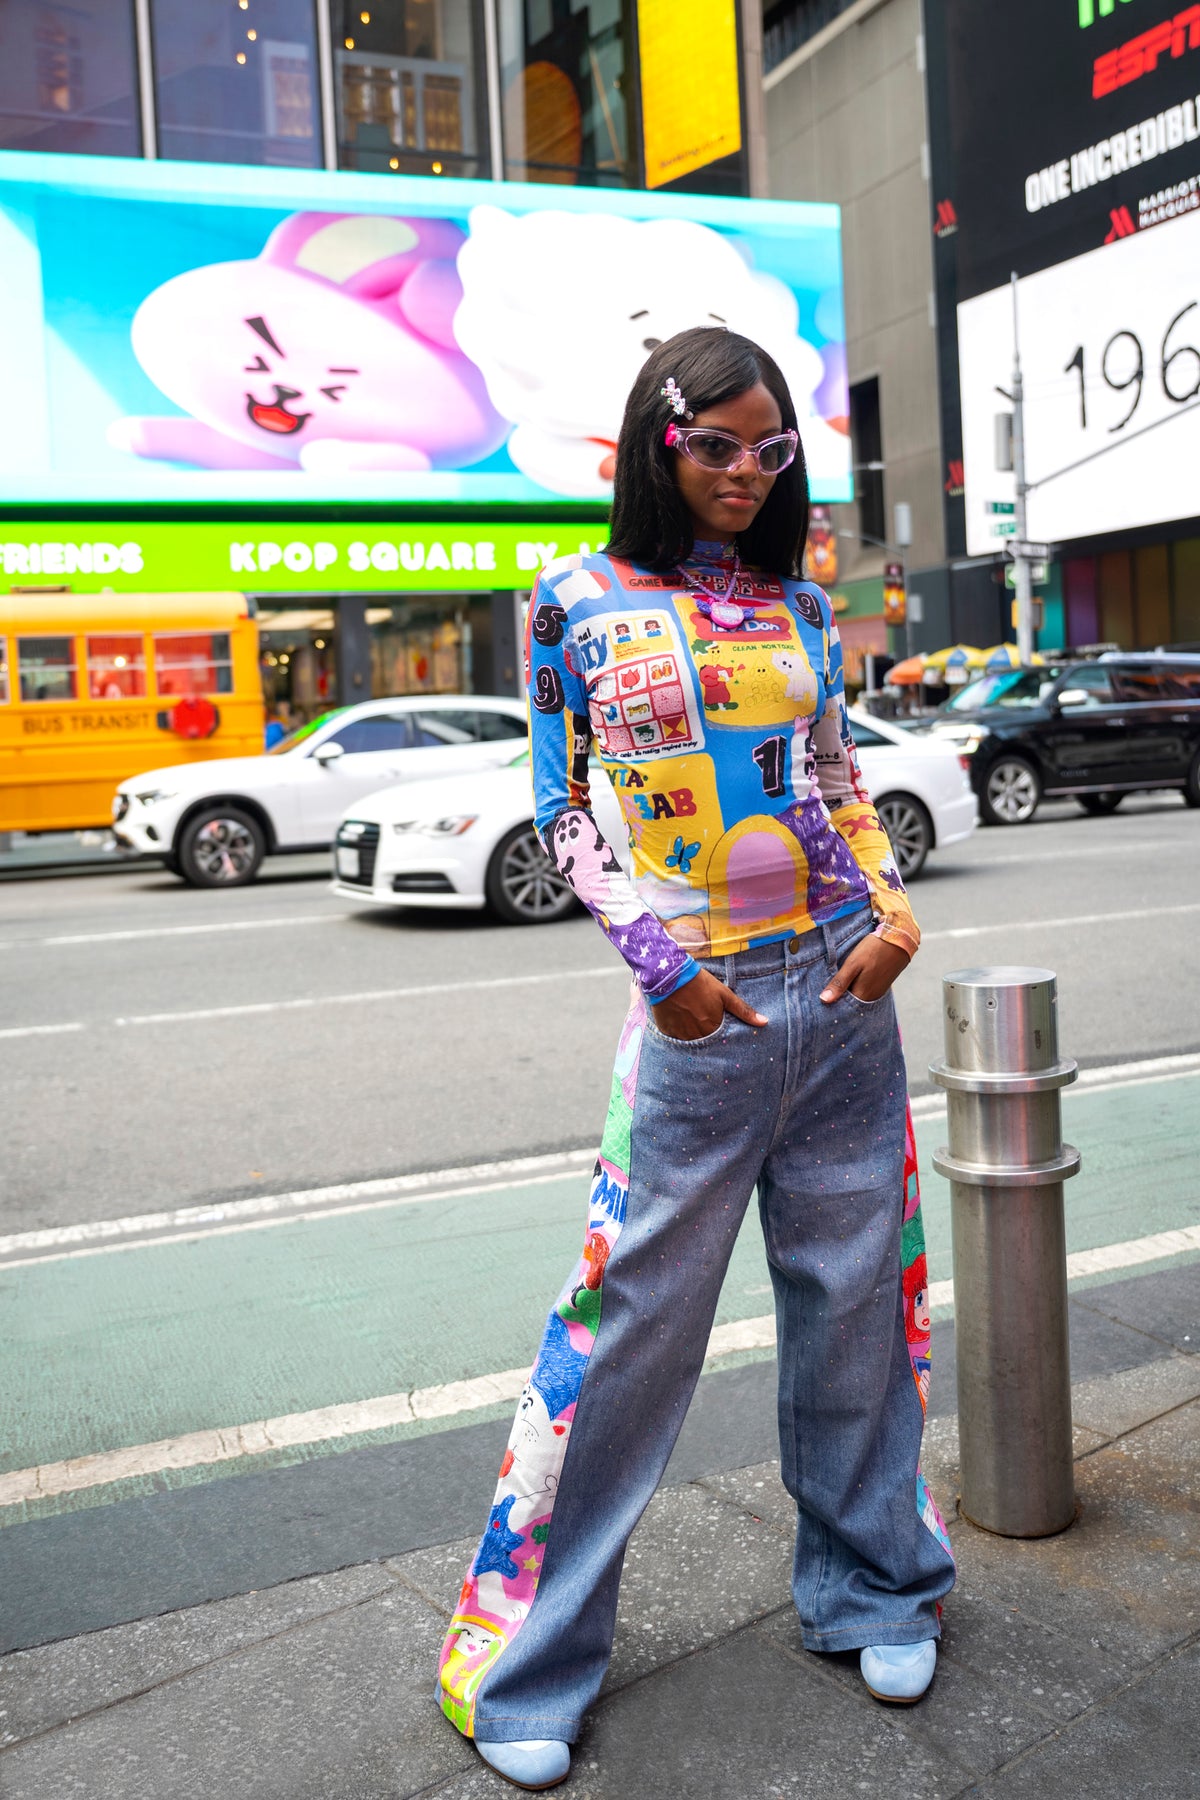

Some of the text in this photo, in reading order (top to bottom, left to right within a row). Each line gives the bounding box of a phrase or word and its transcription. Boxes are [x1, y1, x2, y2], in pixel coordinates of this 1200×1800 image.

[1025, 93, 1200, 213] ONE INCREDIBL
[1138, 174, 1200, 213] MARRIOT
[0, 542, 144, 574] RIENDS
[229, 541, 558, 573] KPOP SQUARE BY
[629, 577, 660, 588] GAME
[532, 603, 568, 646] 5
[793, 591, 824, 630] 9
[532, 664, 566, 714] 9
[23, 713, 149, 734] BUS TRANSIT
[661, 743, 682, 752] required
[752, 735, 787, 799] 1
